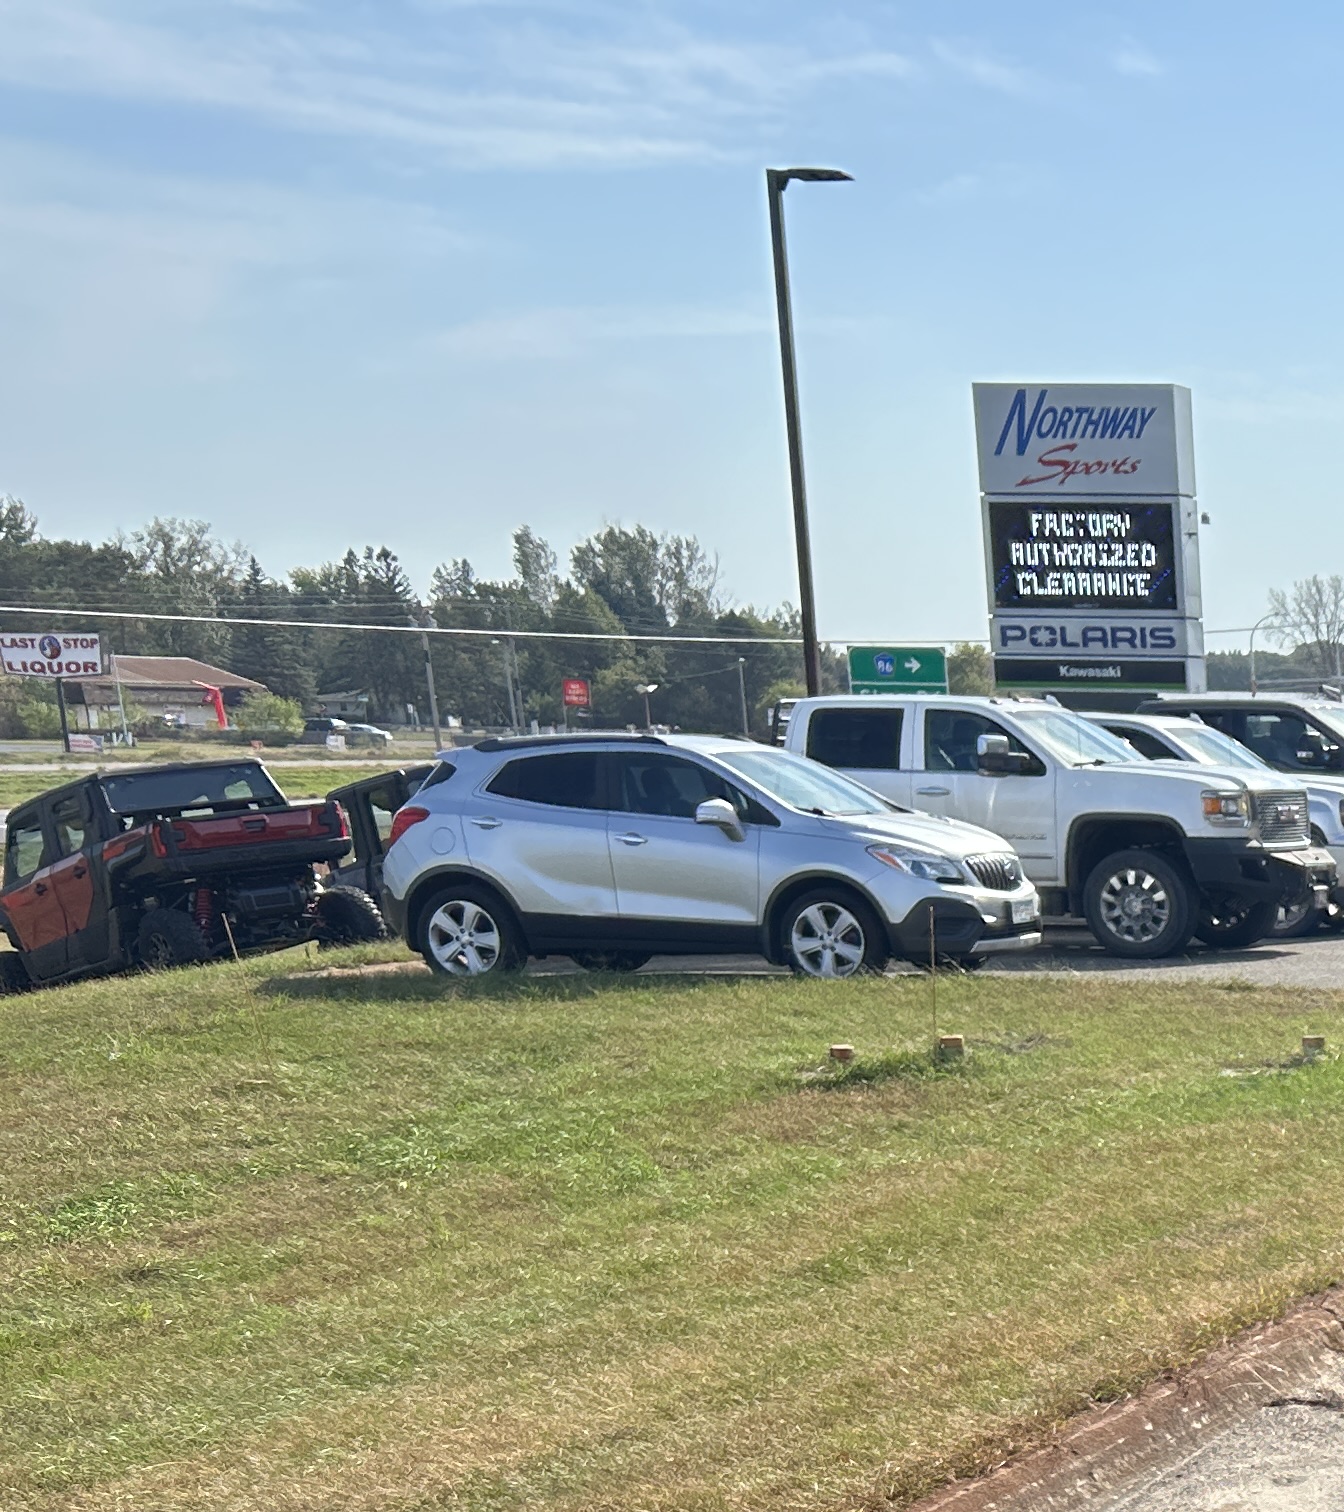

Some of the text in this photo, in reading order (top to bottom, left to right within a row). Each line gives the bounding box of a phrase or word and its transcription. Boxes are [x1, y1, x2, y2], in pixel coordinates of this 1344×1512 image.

[993, 389, 1157, 456] NORTHWAY
[1015, 443, 1142, 487] Sports
[1031, 512, 1131, 537] FACTORY
[1011, 542, 1157, 567] AUTHORIZED
[1016, 572, 1151, 596] CLEARANCE
[0, 638, 98, 649] LAST STOP
[1000, 624, 1176, 649] POLARIS
[6, 661, 98, 674] LIQUOR
[1060, 665, 1121, 678] Kawasaki
